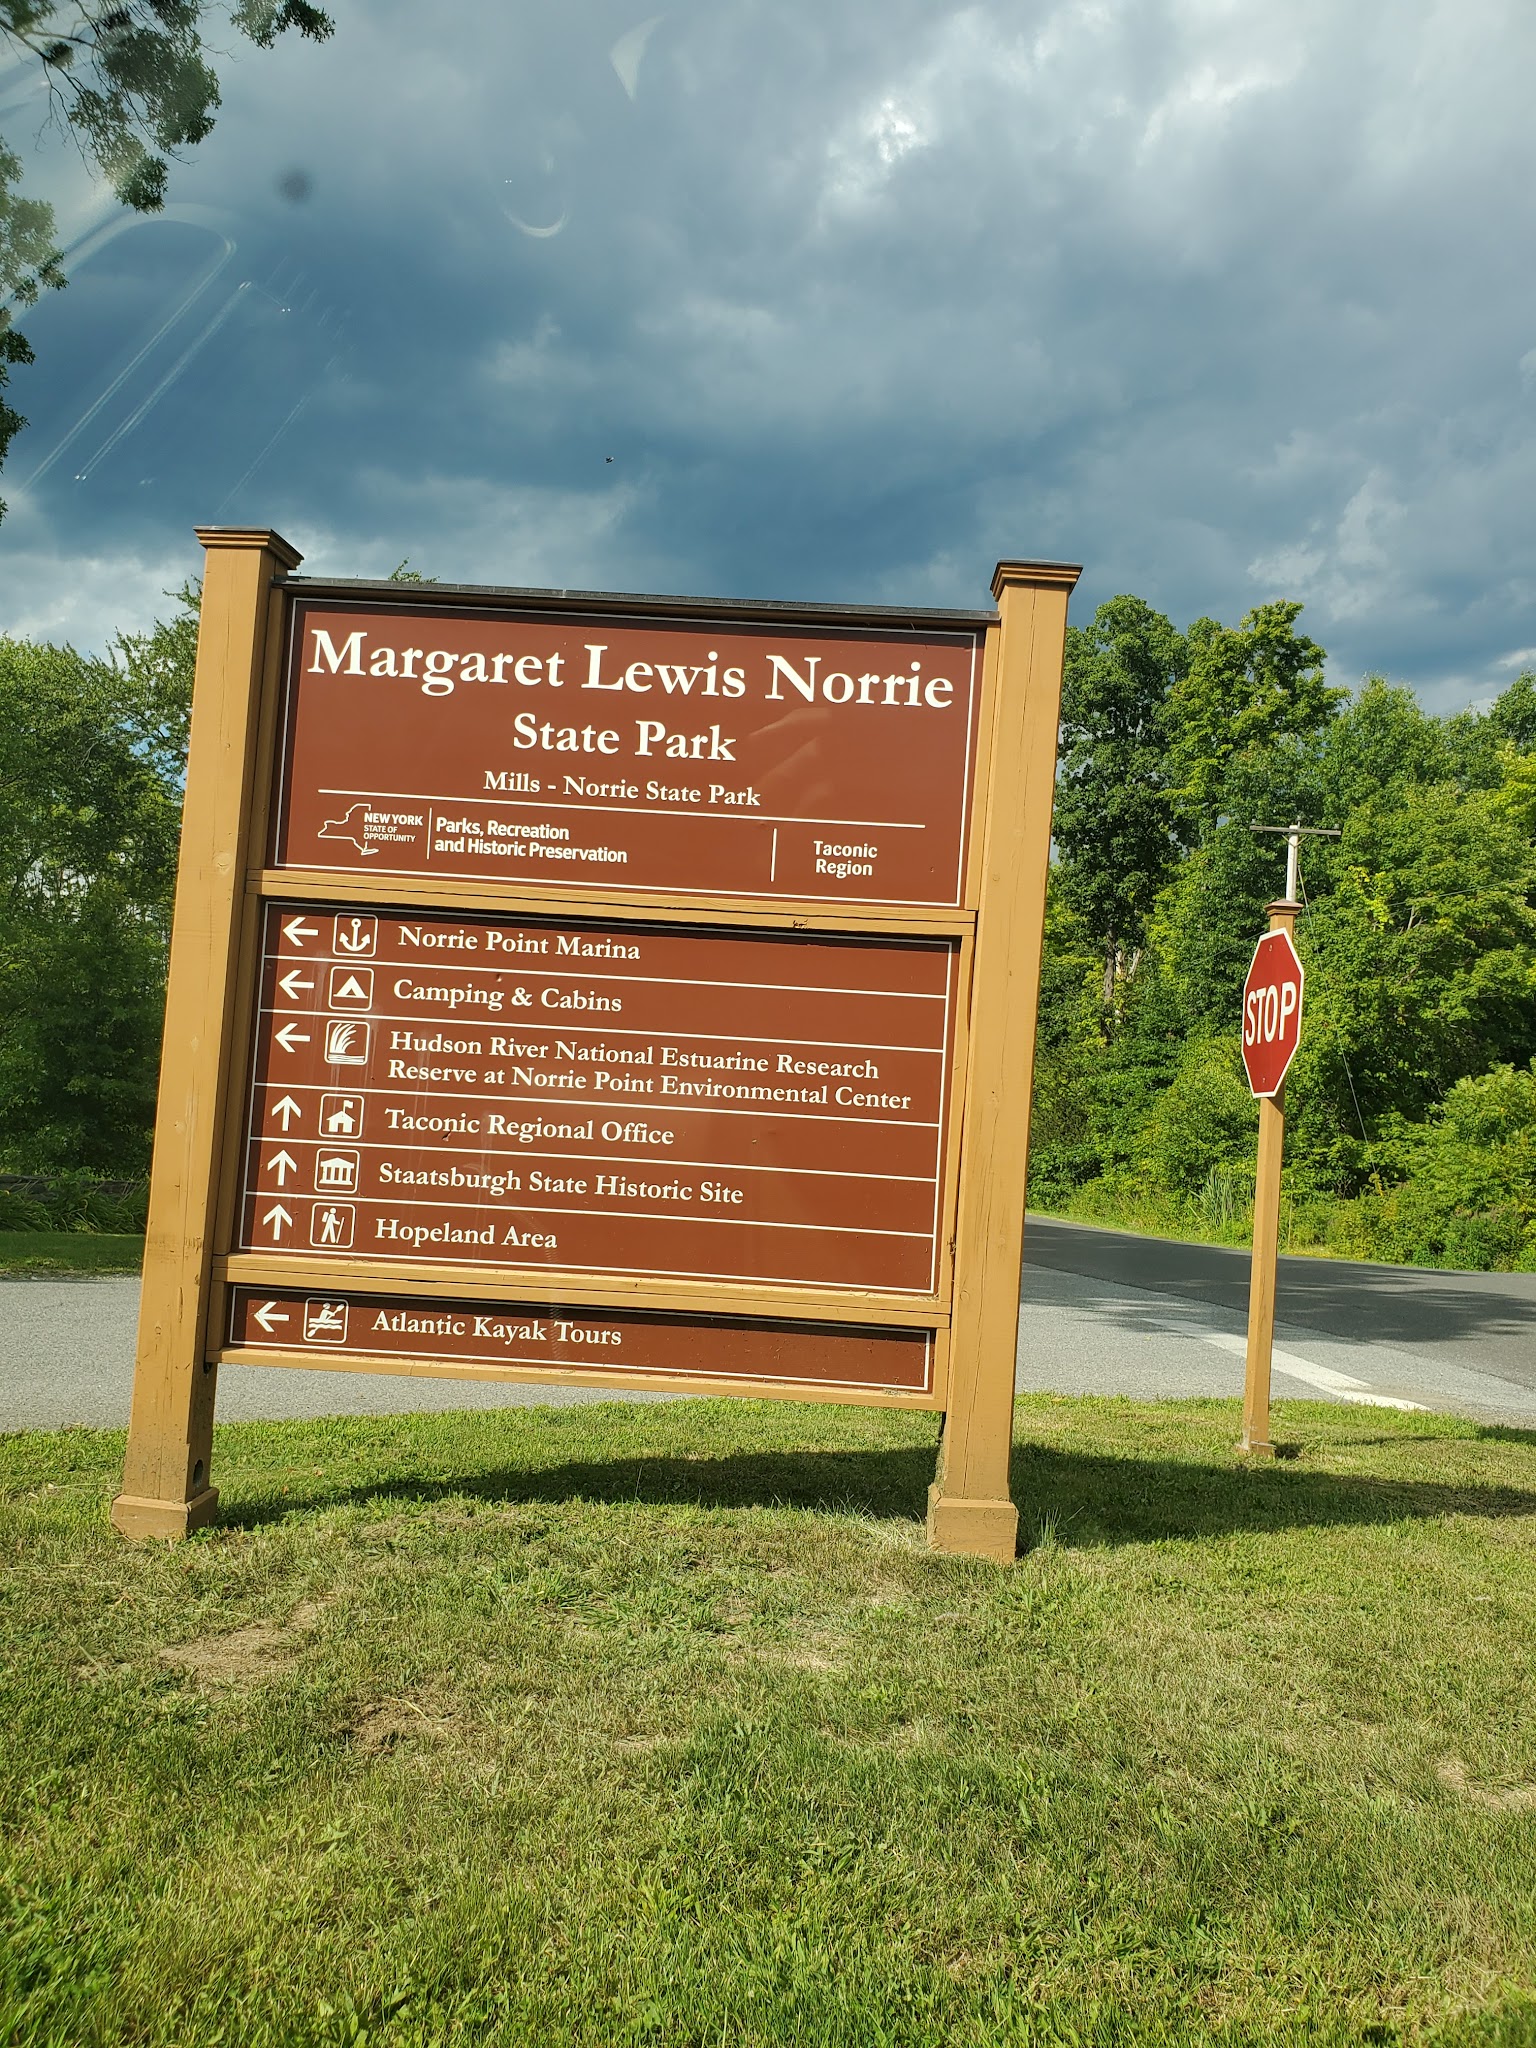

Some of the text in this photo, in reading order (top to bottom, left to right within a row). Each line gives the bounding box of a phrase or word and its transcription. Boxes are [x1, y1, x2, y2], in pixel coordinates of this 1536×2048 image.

[308, 630, 953, 708] Margaret Lewis Norrie
[514, 713, 736, 761] State Park
[483, 771, 540, 792] Mills
[563, 776, 638, 798] Norrie
[646, 781, 701, 802] State
[708, 785, 760, 805] Park
[364, 813, 423, 826] NEW YORK
[437, 817, 569, 840] Parks, Recreation
[364, 832, 415, 842] OPPORTUNITY
[435, 837, 627, 863] and Historic Preservation
[814, 841, 877, 858] Taconic
[816, 859, 872, 878] Region
[398, 926, 640, 959] Norrie Point Marina
[394, 979, 621, 1011] Camping & Cabins
[1246, 982, 1296, 1046] STOP
[390, 1031, 879, 1078] Hudson River National Estuarine Research
[388, 1060, 911, 1109] Reserve at Norrie Point Environmental Center
[385, 1108, 674, 1144] Taconic Regional Office
[380, 1163, 743, 1203] Staatsburgh State Historic Site
[375, 1219, 557, 1248] Hopeland Area
[371, 1311, 621, 1345] Atlantic Kayak Tours
